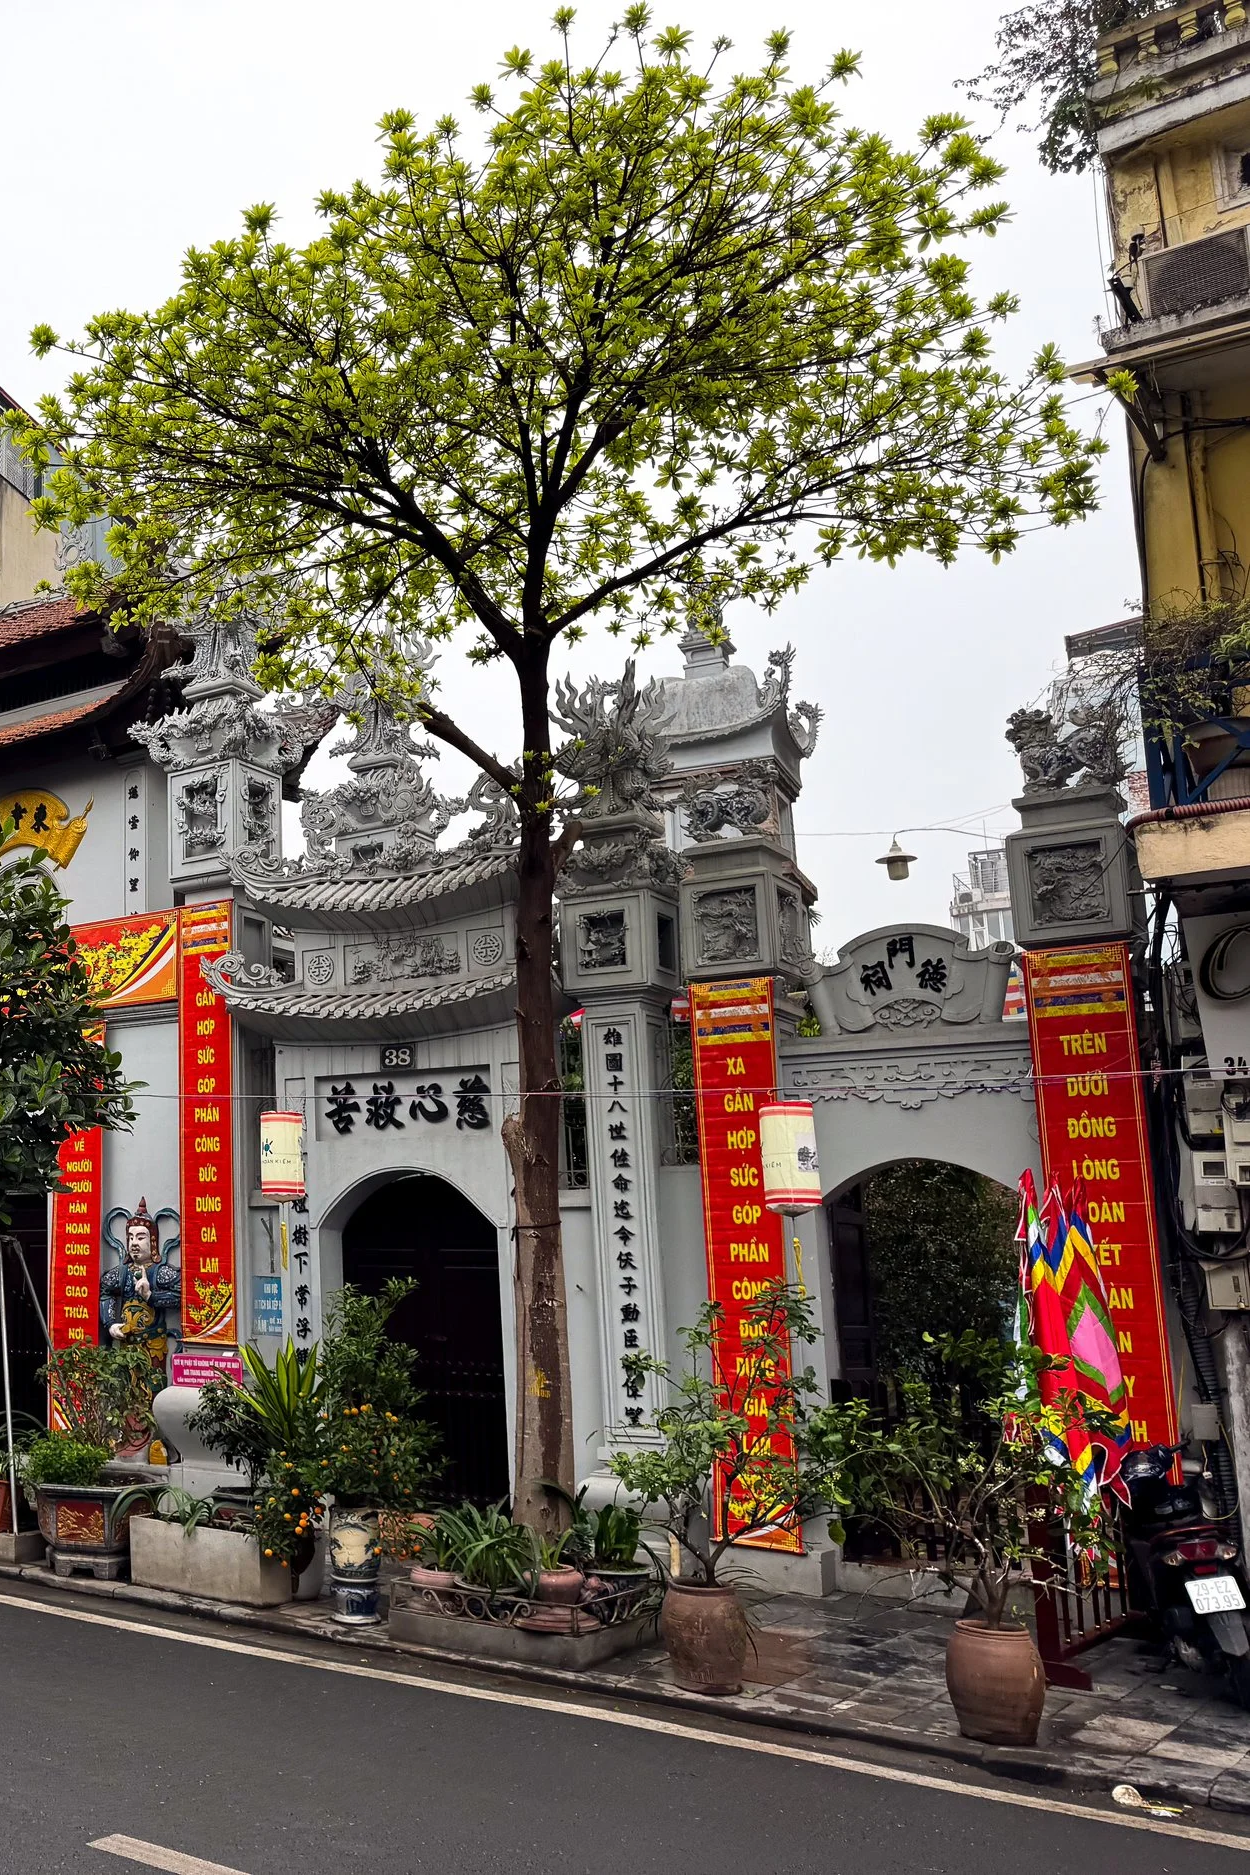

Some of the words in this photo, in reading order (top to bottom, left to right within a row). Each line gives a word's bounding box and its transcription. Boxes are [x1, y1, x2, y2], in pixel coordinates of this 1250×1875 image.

[196, 986, 216, 1007] GẦN
[197, 1017, 216, 1039] HỢP
[1059, 1029, 1107, 1056] TRÊN
[197, 1046, 216, 1065] SỨC
[383, 1048, 411, 1067] 38
[726, 1056, 746, 1076] XA
[1224, 1056, 1249, 1076] 34
[197, 1074, 216, 1093] GÓP
[1066, 1069, 1109, 1097] DƯỚI
[724, 1086, 754, 1113] GẦN
[194, 1102, 220, 1123] PHẦN
[1067, 1109, 1117, 1139] ĐỒNG
[74, 1137, 85, 1152] VỀ
[195, 1134, 221, 1153] CÔNG
[726, 1126, 756, 1155] HỢP
[66, 1158, 93, 1172] NGƯỜI
[198, 1163, 218, 1182] ĐỨC
[730, 1163, 759, 1187] SỨC
[1072, 1153, 1121, 1181] LÒNG
[196, 1194, 222, 1217] DỰNG
[732, 1200, 762, 1225] GÓP
[1087, 1195, 1126, 1223] OÀN
[65, 1223, 91, 1235] HOAN
[201, 1222, 218, 1243] GIÀ
[65, 1241, 90, 1255] CÙNG
[729, 1236, 770, 1263] PHẦN
[67, 1262, 87, 1277] ĐÓN
[200, 1257, 219, 1273] LAM
[65, 1286, 88, 1298] GIAO
[732, 1277, 771, 1301] CÔNG
[1108, 1281, 1134, 1310] ÀN
[64, 1304, 89, 1319] THỪA
[744, 1393, 769, 1417] GIÀ
[1196, 1595, 1240, 1611] 073.95
